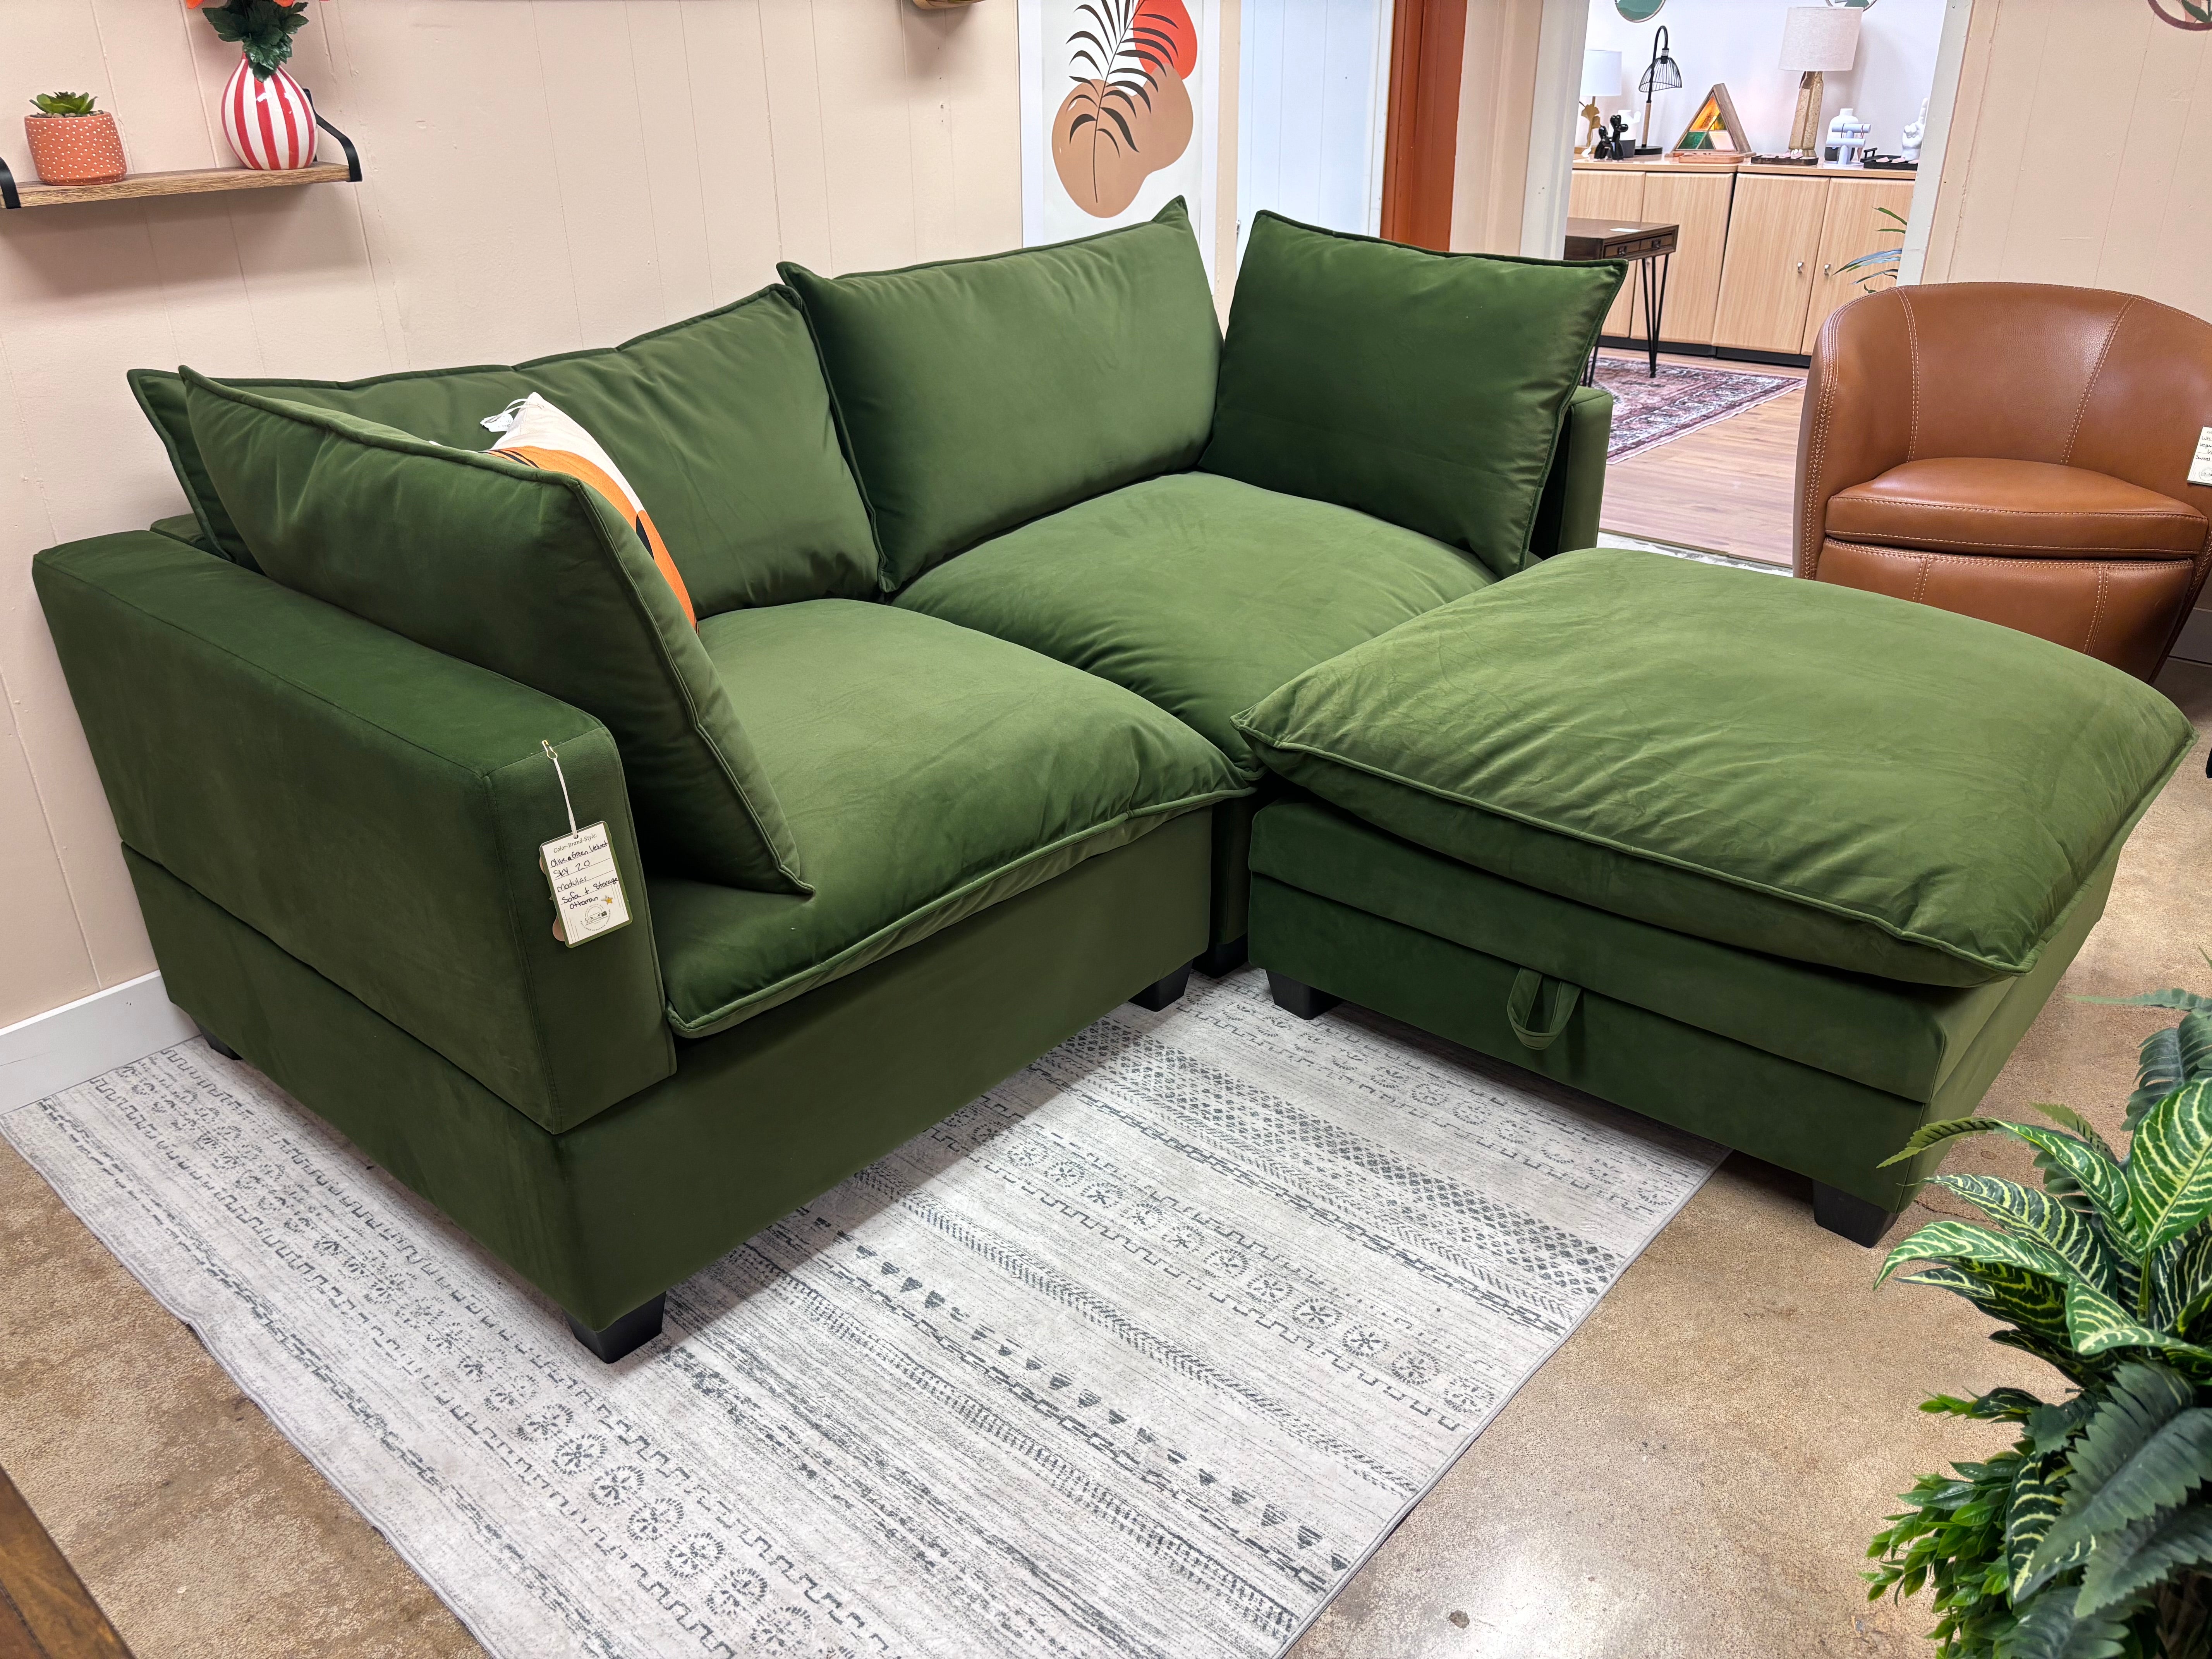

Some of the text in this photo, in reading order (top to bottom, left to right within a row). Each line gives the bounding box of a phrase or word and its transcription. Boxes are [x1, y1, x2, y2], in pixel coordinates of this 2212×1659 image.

[589, 840, 608, 852] Velvet
[562, 891, 581, 903] Sofa
[593, 878, 618, 890] Storage
